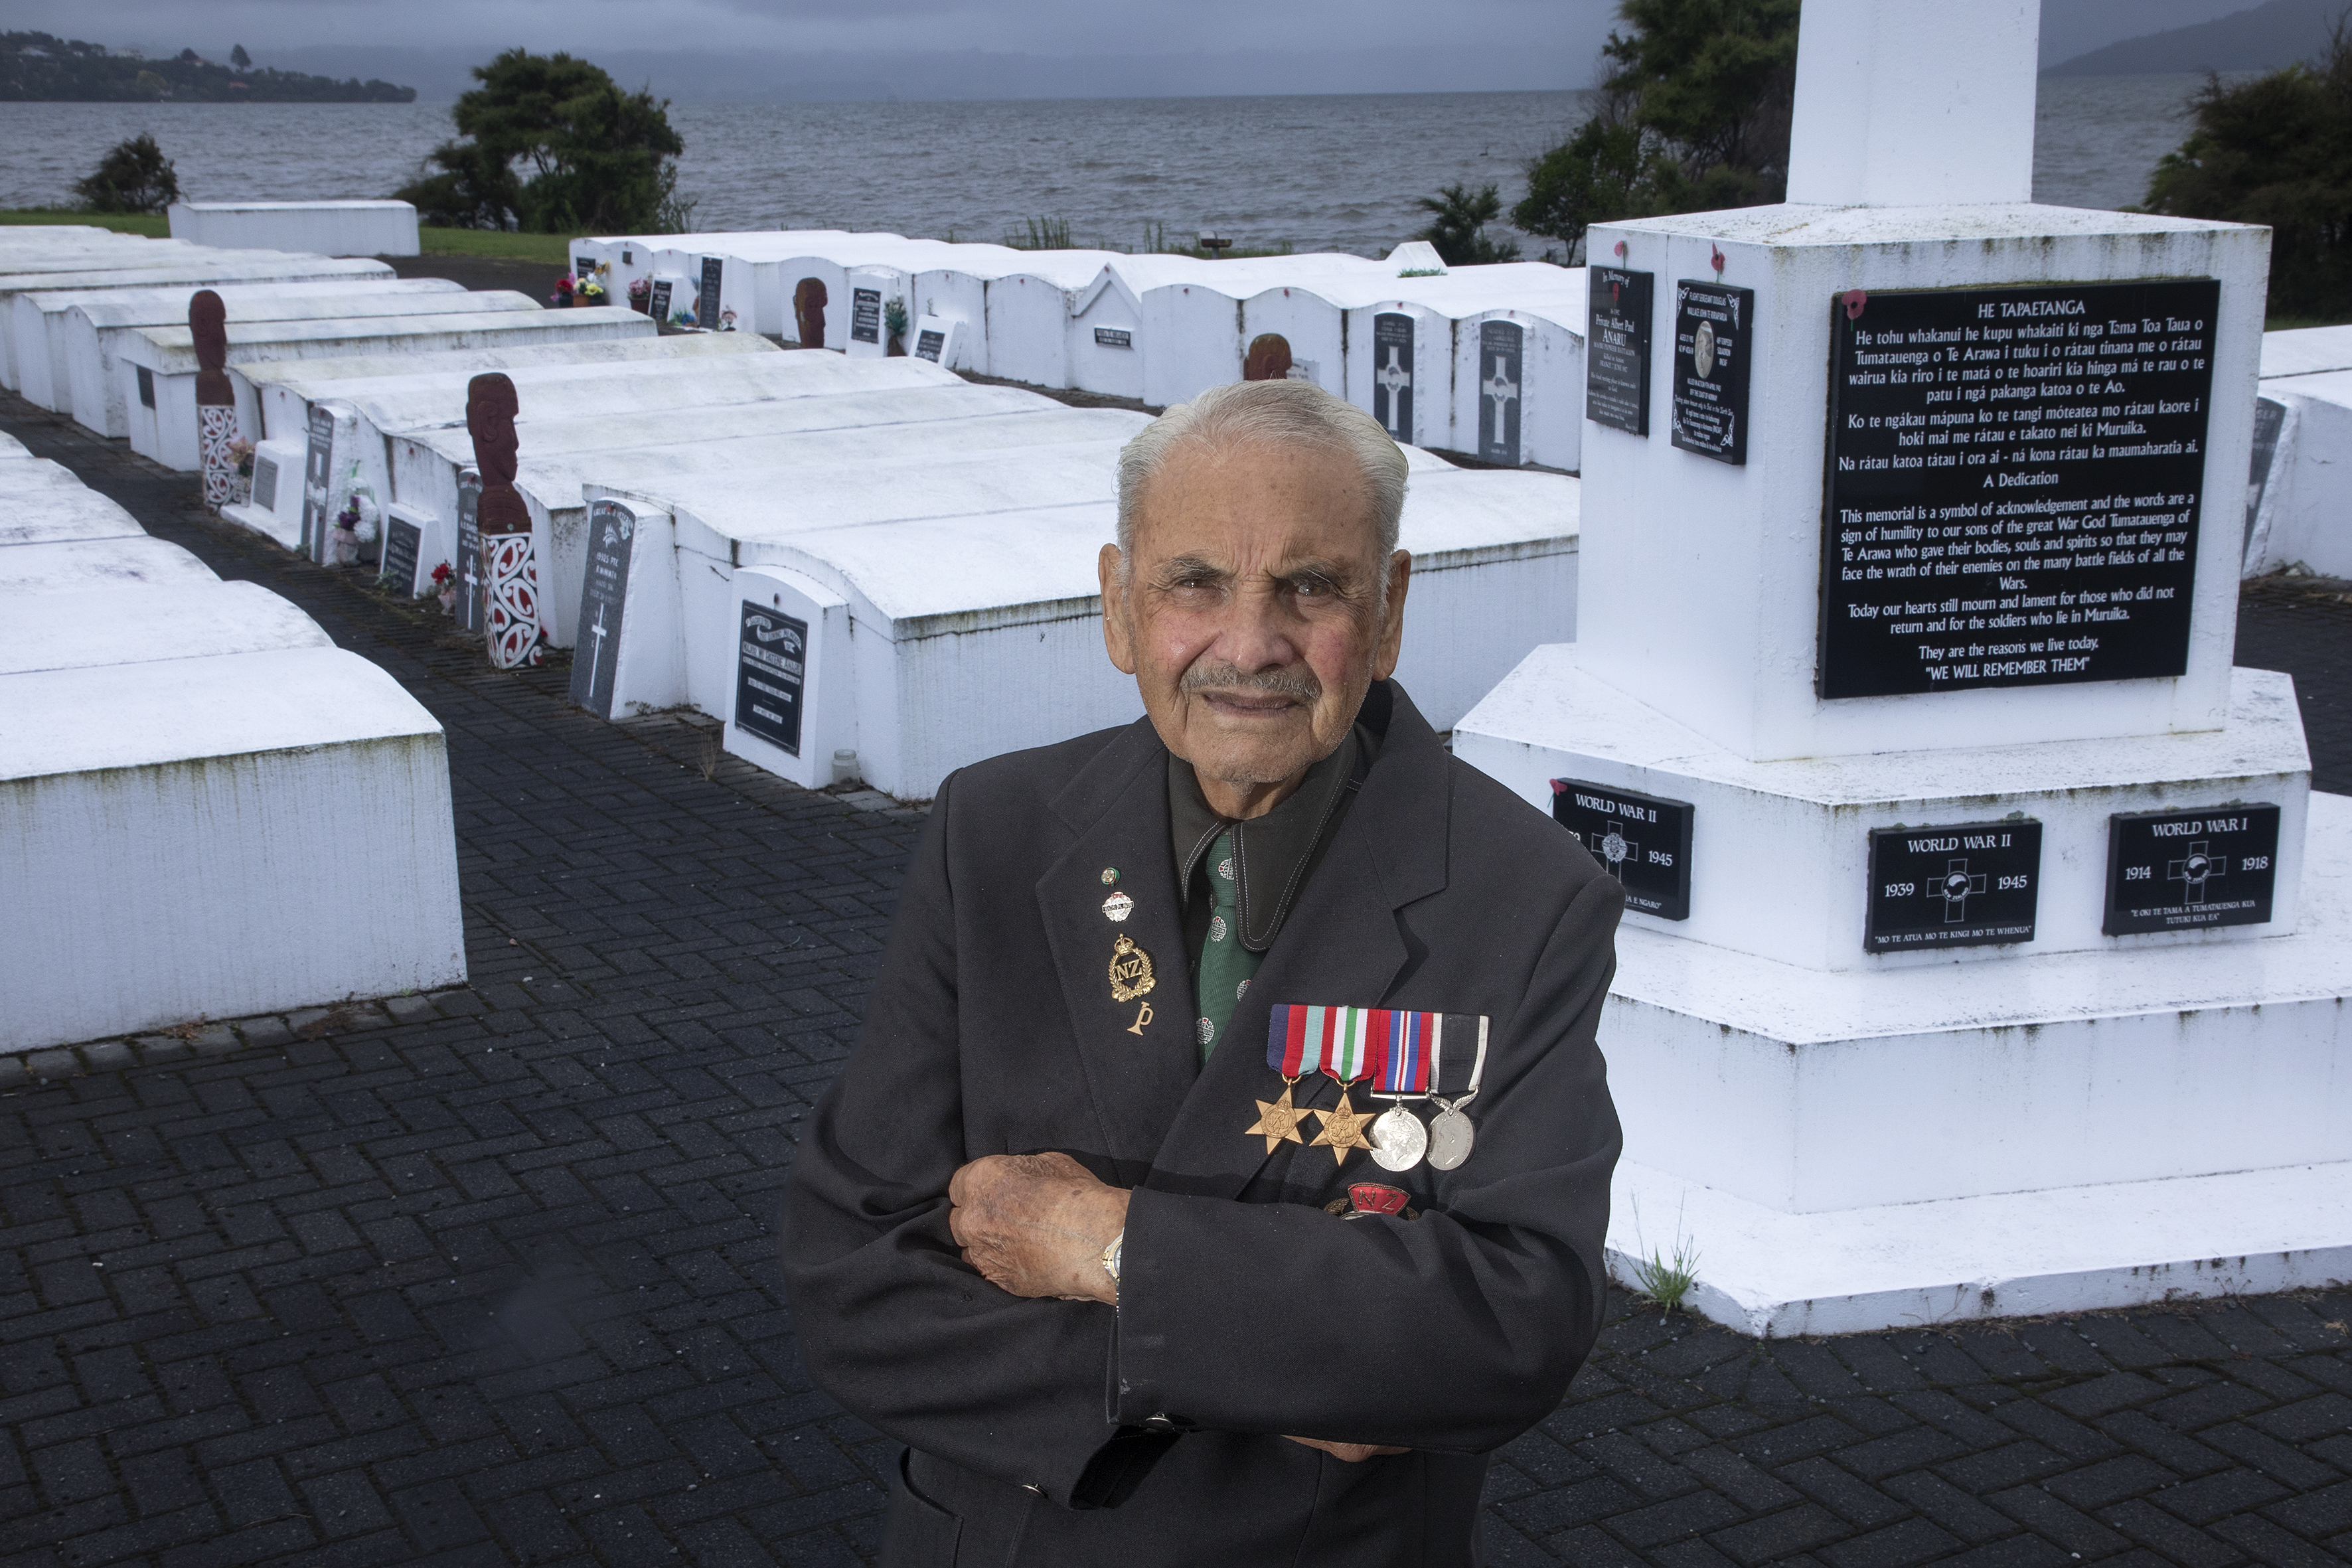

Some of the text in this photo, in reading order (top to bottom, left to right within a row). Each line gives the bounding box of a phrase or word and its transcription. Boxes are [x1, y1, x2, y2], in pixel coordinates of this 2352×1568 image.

[1608, 270, 1624, 285] Memory
[1624, 277, 1630, 288] of
[1978, 299, 2085, 318] HE TAPAETANGA
[1596, 314, 1610, 327] Private
[1610, 318, 1624, 330] Albert
[1603, 328, 1626, 347] ANARU
[1982, 470, 2059, 488] A Dedication
[1840, 491, 2194, 523] This memorial is a symbol of acknowledgement and the words are a
[1840, 509, 2191, 544] sign of humility to our sons of the great War God Tumatauenga of
[1841, 530, 2187, 562] Te Arawa who gave their bodies, souls and spirits so that they may
[1842, 547, 2185, 580] face the wrath of their enemies on the many battle fields of all the
[1999, 576, 2027, 590] Wars.
[1847, 586, 2175, 619] Today our hearts still mourn and lament for those who did not
[1890, 606, 2130, 634] return and for the soldiers who lie in Muruika.
[1918, 635, 2098, 661] They are the reasons we live today.
[1925, 656, 2090, 680] "WE WILL REMEMBER THEM"
[1575, 794, 1657, 823] WORLD WAR II
[2152, 817, 2247, 836] WORLD WAR I
[1907, 834, 2011, 852] WORLD WAR II
[1648, 850, 1673, 866] 1945
[2242, 856, 2268, 870] 1918
[1998, 874, 2027, 889] 1945
[2126, 866, 2151, 880] 1914
[1885, 882, 1914, 897] 1939
[1952, 887, 1969, 900] ZEALAND
[2192, 901, 2240, 911] TUMATAUENGA
[1950, 929, 1969, 938] KINGI
[1115, 959, 1142, 981] NZ
